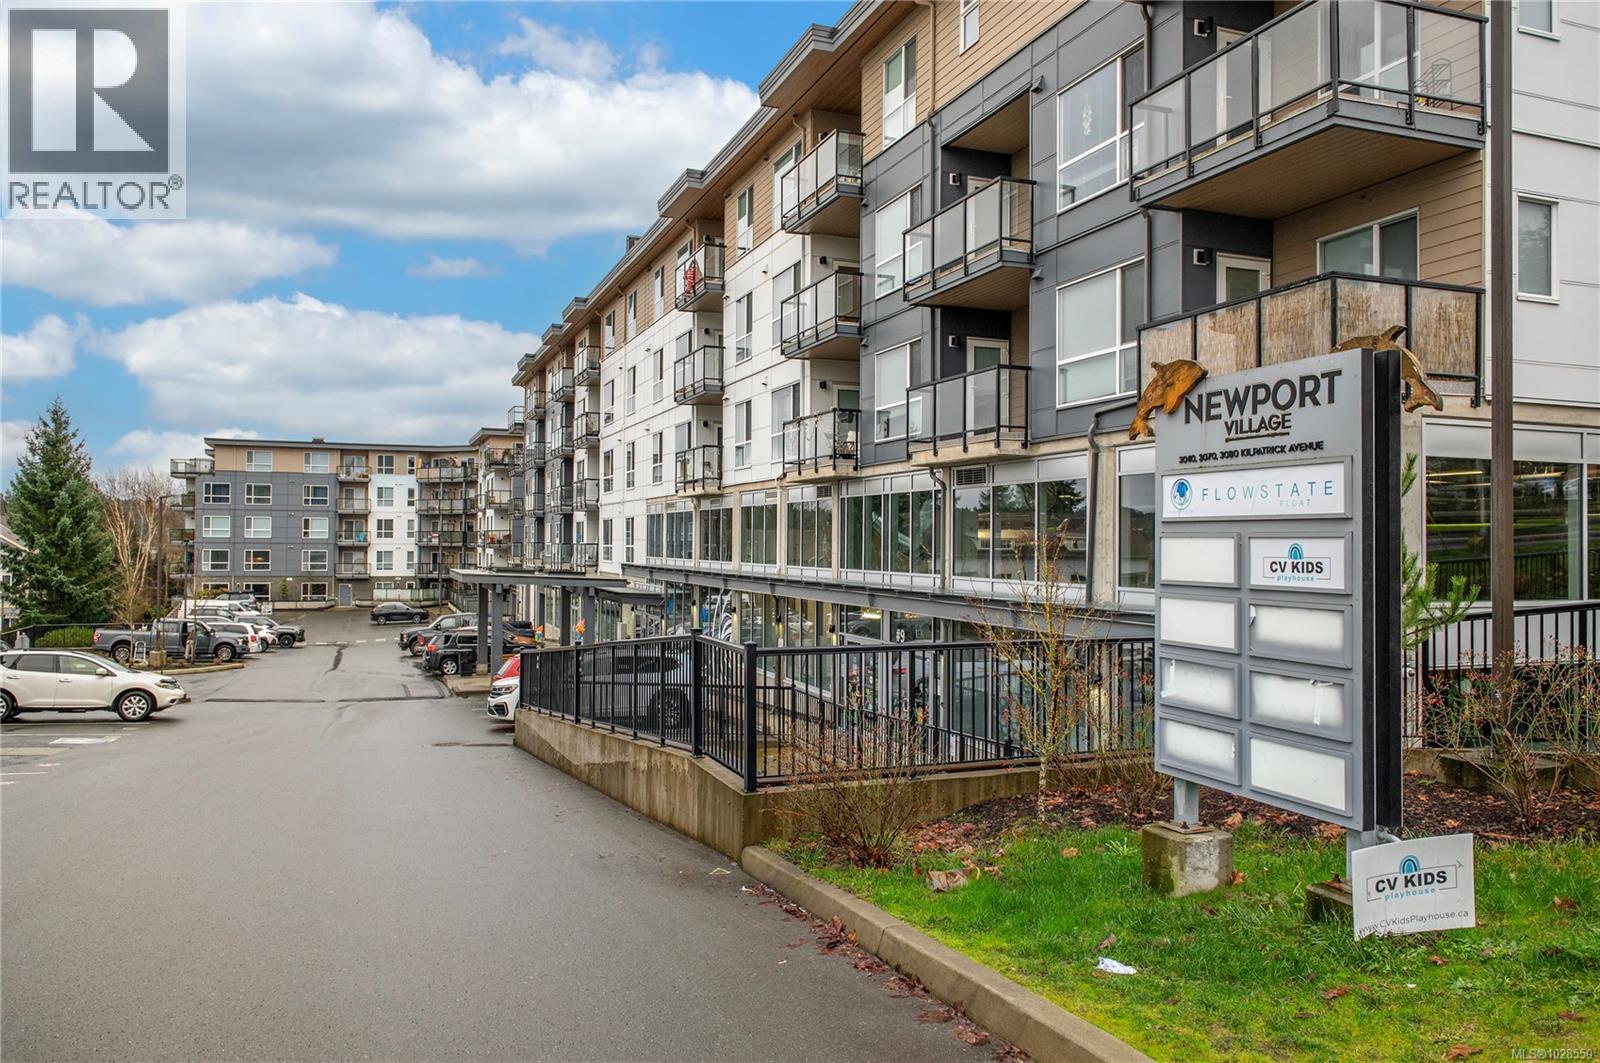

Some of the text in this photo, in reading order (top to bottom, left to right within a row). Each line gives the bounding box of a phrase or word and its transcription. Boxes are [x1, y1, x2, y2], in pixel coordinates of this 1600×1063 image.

[1184, 369, 1342, 424] NEWPORT
[1224, 412, 1292, 437] VILLAGE
[1241, 445, 1287, 457] KILPATRICK
[1288, 441, 1324, 452] AVENUE
[1201, 480, 1333, 501] FLOWSTATE
[1279, 499, 1311, 507] FLOAT
[1270, 561, 1324, 574] CV KIDS
[1375, 871, 1447, 893] CV KIDS
[1385, 887, 1436, 901] playhouse
